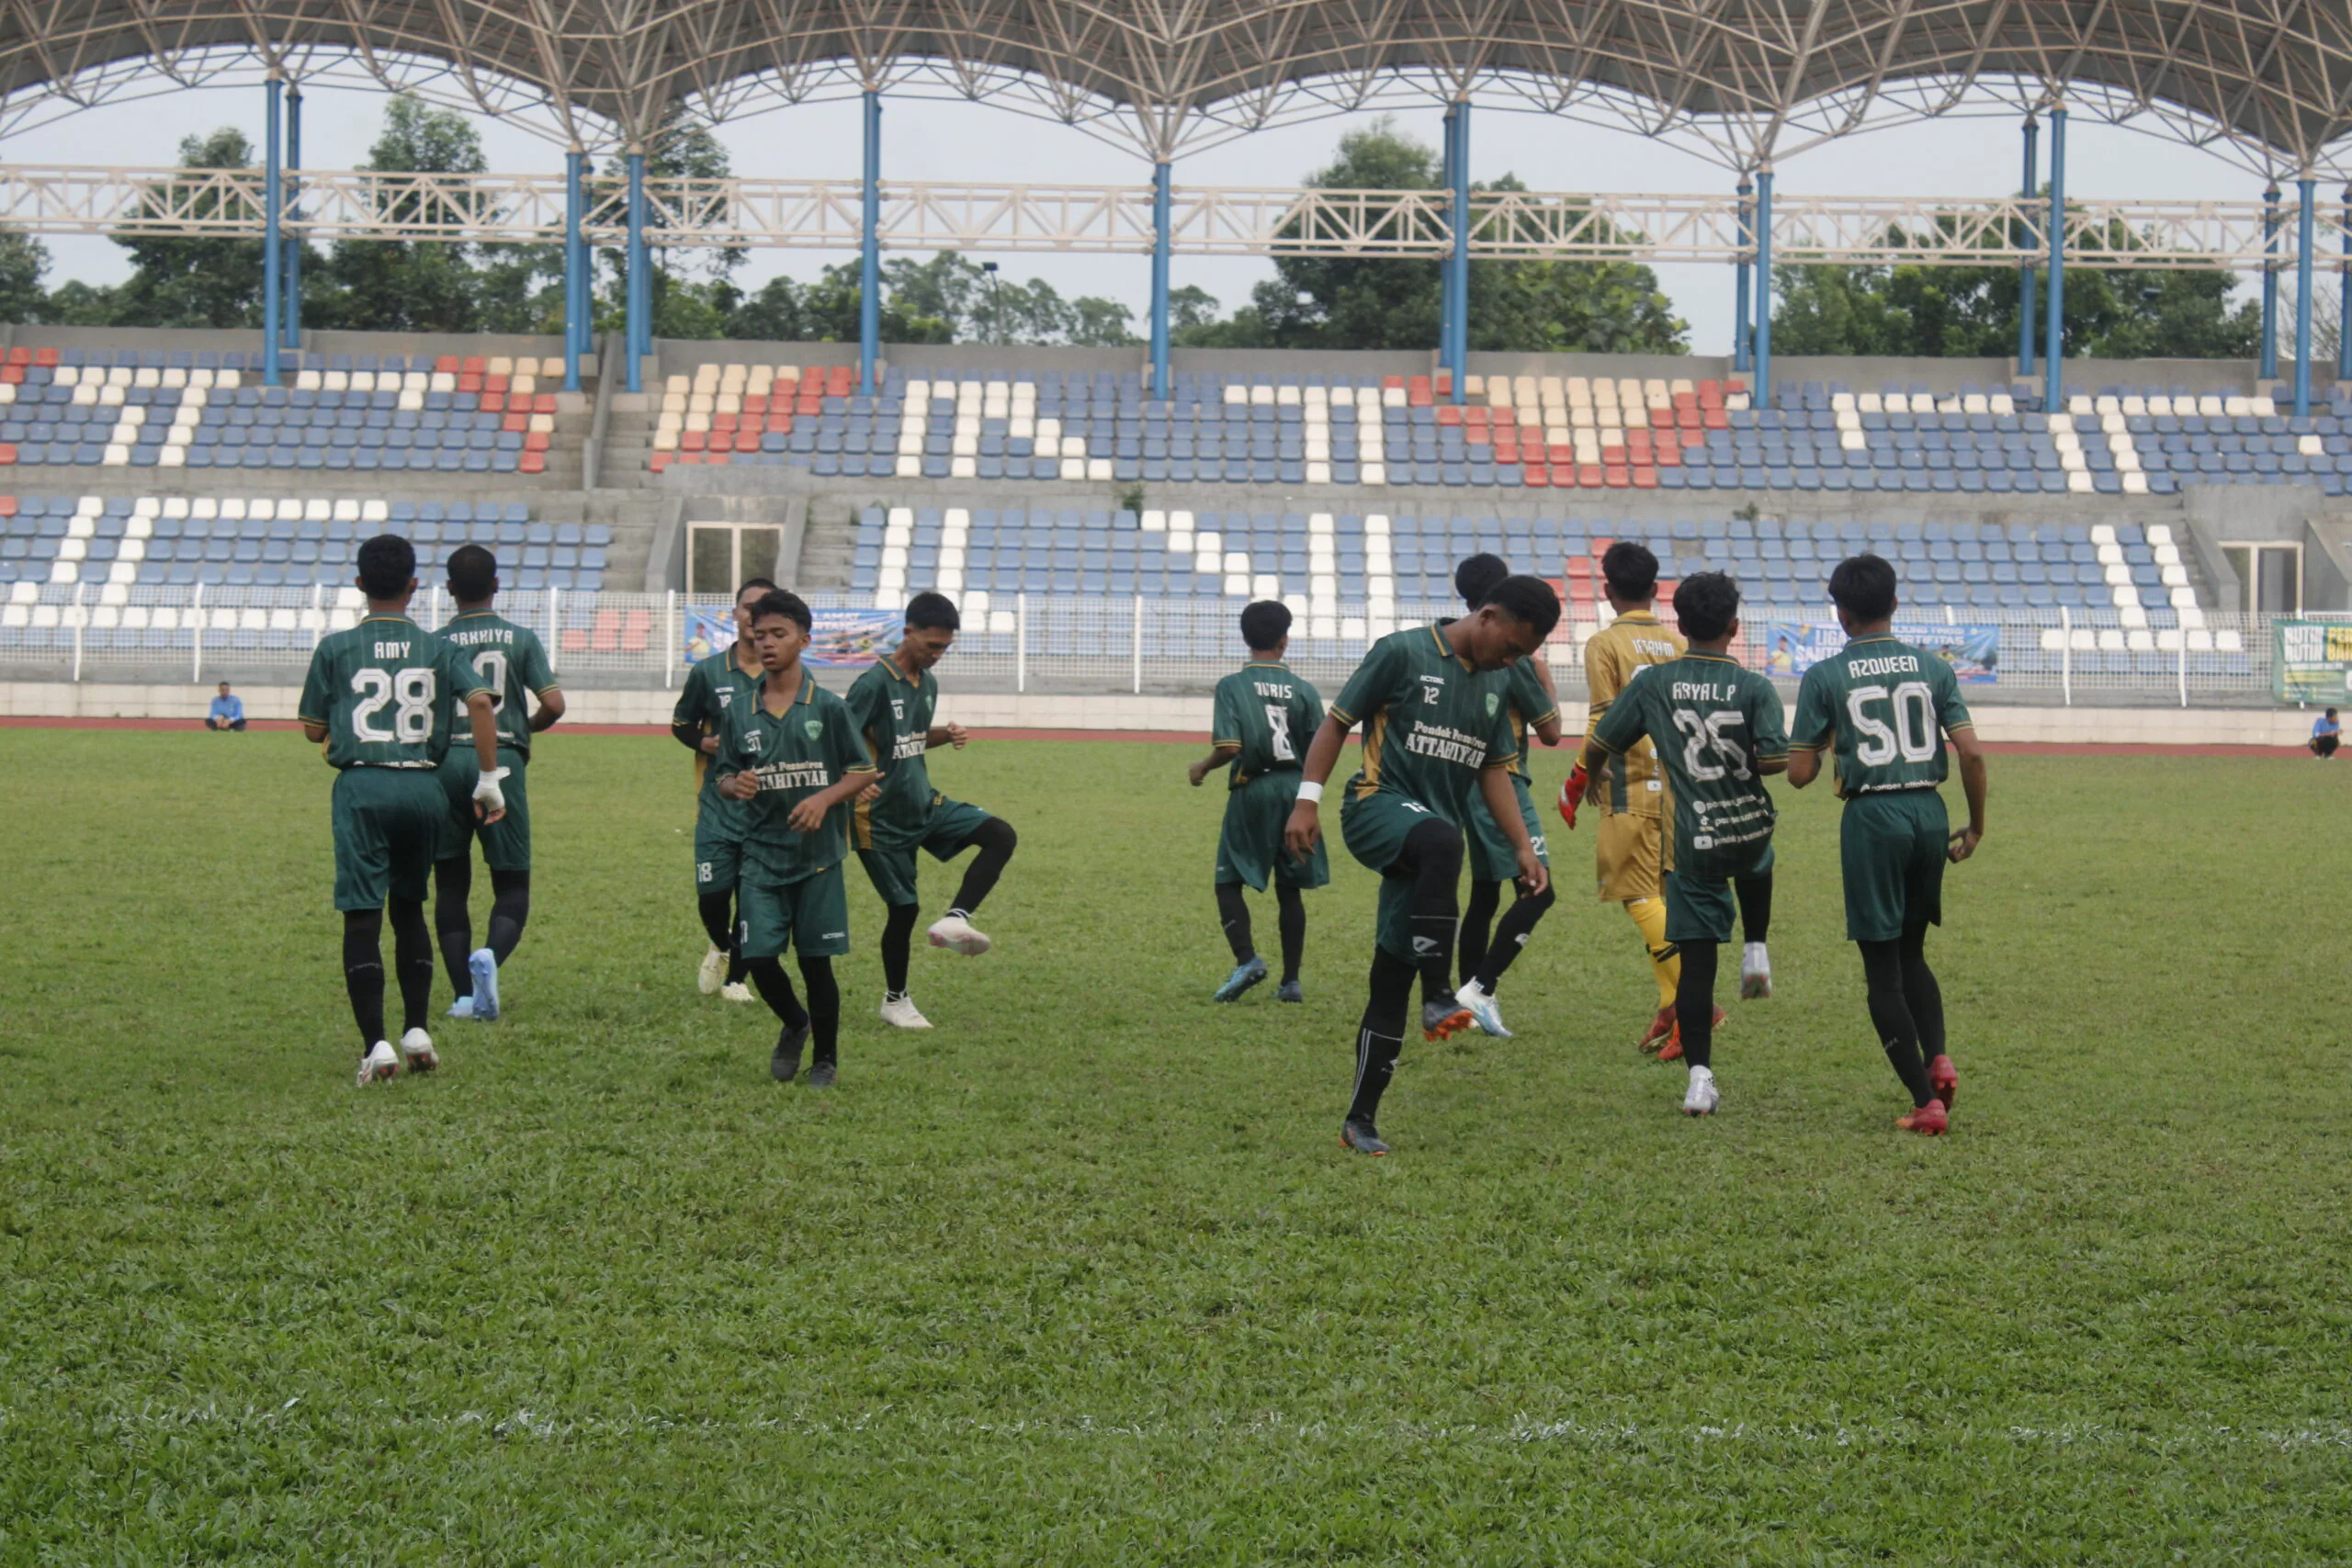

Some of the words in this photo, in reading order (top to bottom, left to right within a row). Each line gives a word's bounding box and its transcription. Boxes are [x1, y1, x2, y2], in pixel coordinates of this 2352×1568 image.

[375, 641, 411, 659] AMY
[1848, 655, 1919, 679] AZQUEEN
[351, 668, 435, 744] 28
[1423, 685, 1441, 705] 12
[1264, 705, 1296, 761] 8
[1672, 708, 1752, 781] 25
[1847, 682, 1937, 766] 50
